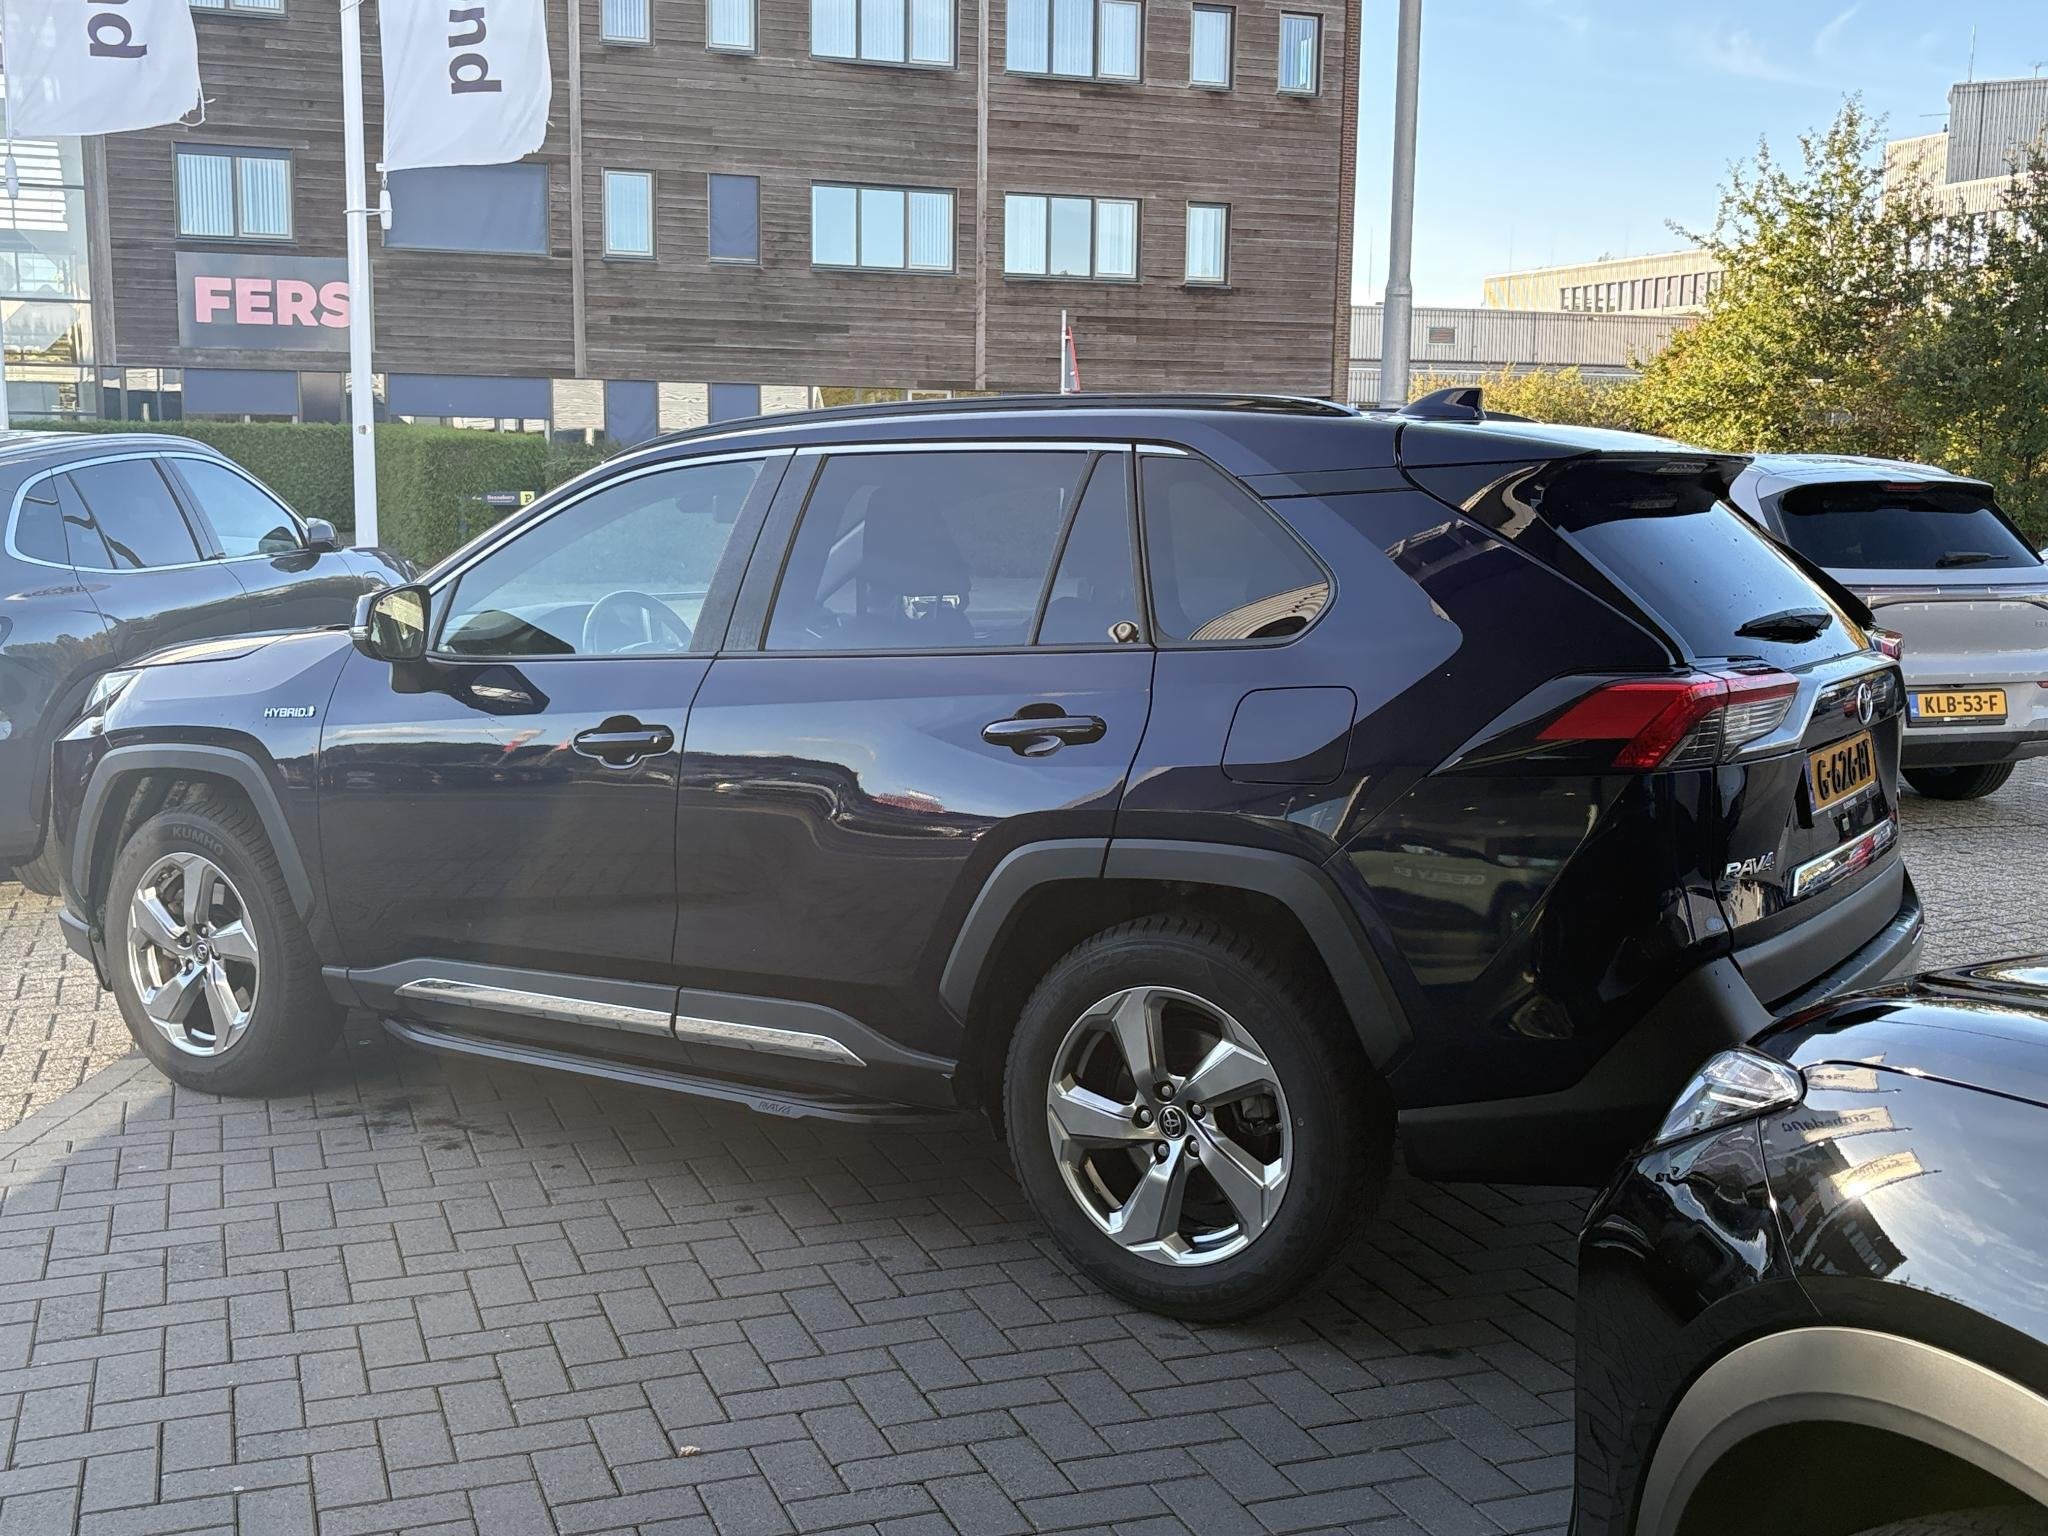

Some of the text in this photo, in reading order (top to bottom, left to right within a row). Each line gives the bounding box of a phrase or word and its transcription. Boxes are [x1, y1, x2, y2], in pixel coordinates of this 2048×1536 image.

[524, 494, 532, 502] P
[264, 707, 308, 717] HYBRID
[1925, 695, 1997, 714] KLB-53-F
[1817, 738, 1870, 800] G-626-BT
[172, 826, 224, 856] KUMHO
[1723, 851, 1775, 880] RAV4
